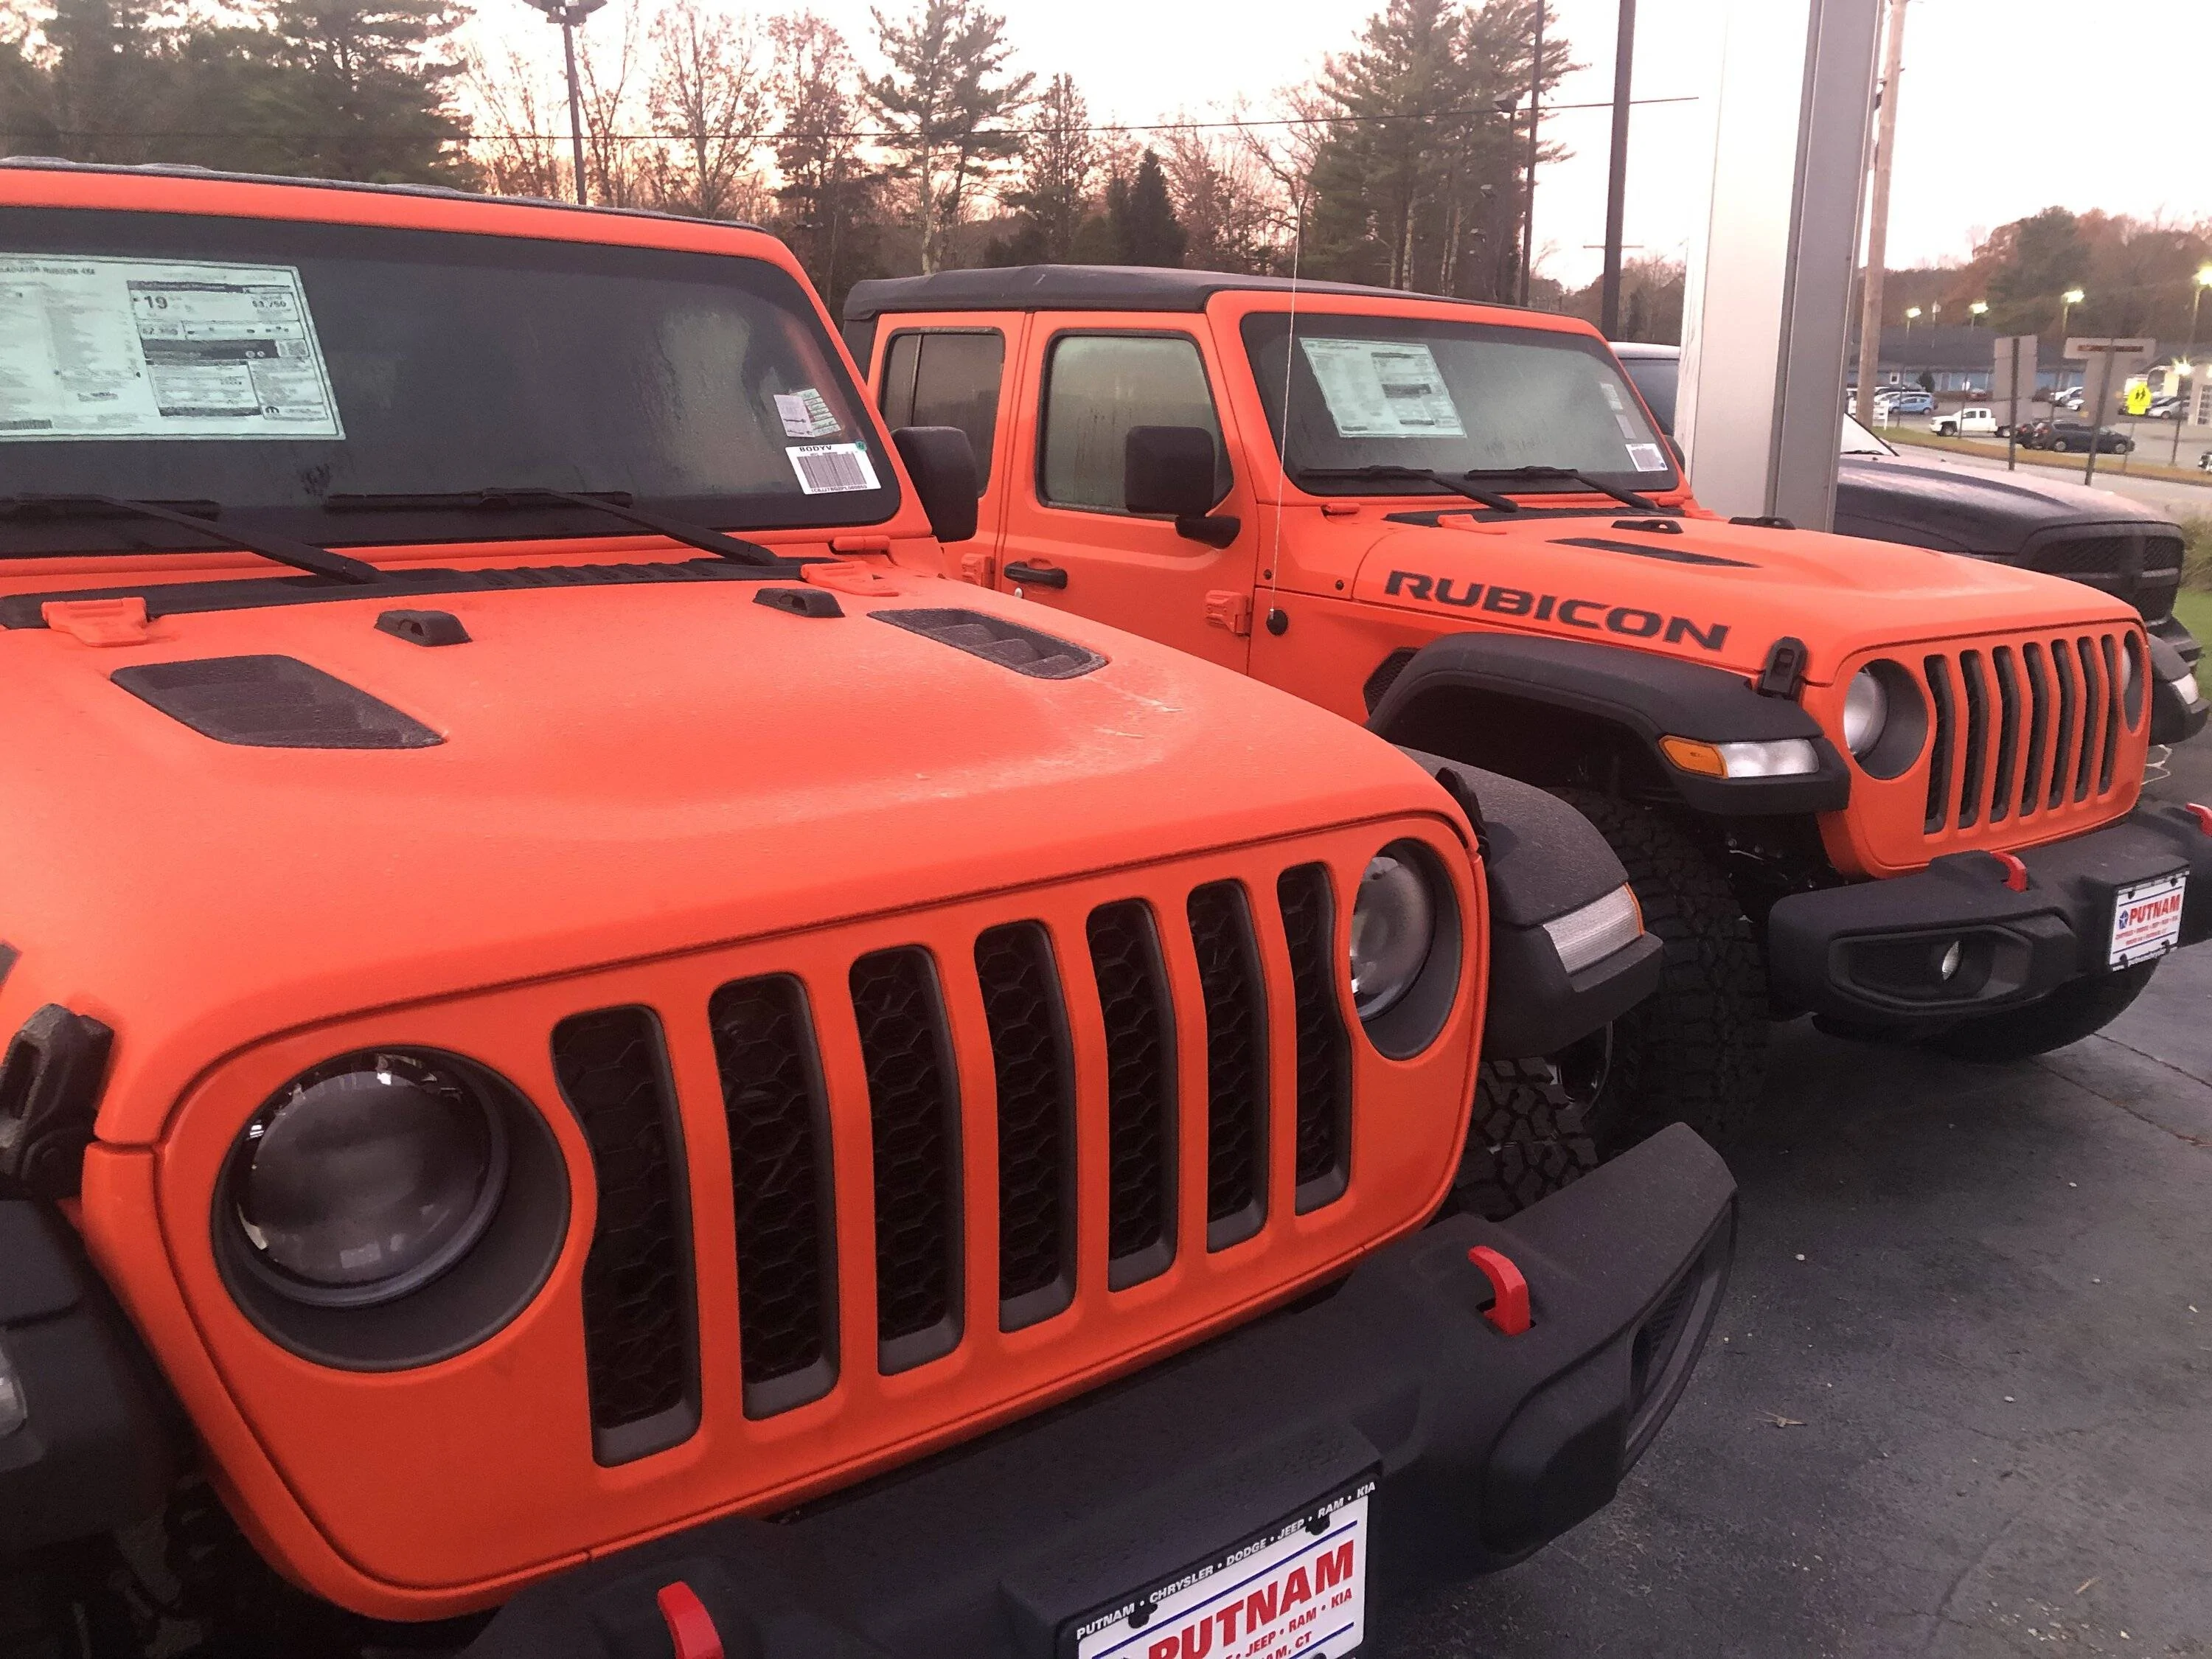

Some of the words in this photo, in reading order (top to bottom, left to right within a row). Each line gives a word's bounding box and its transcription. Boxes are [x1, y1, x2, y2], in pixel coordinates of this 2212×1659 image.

[145, 296, 167, 309] 19
[1383, 570, 1731, 652] RUBICON
[2129, 894, 2181, 926] PUTNAM
[1077, 1603, 1135, 1641] PUTNAM
[1150, 1565, 1214, 1604] CHRYSLER
[1226, 1538, 1267, 1567] DODGE
[1277, 1518, 1305, 1541] JEEP
[1318, 1498, 1344, 1518] RAM
[1357, 1481, 1376, 1498] KIA
[1148, 1539, 1354, 1659] PUTNAM
[1245, 1630, 1276, 1658] JEEP
[1289, 1607, 1317, 1633] RAM
[1331, 1587, 1352, 1609] KIA
[1295, 1631, 1312, 1649] CT
